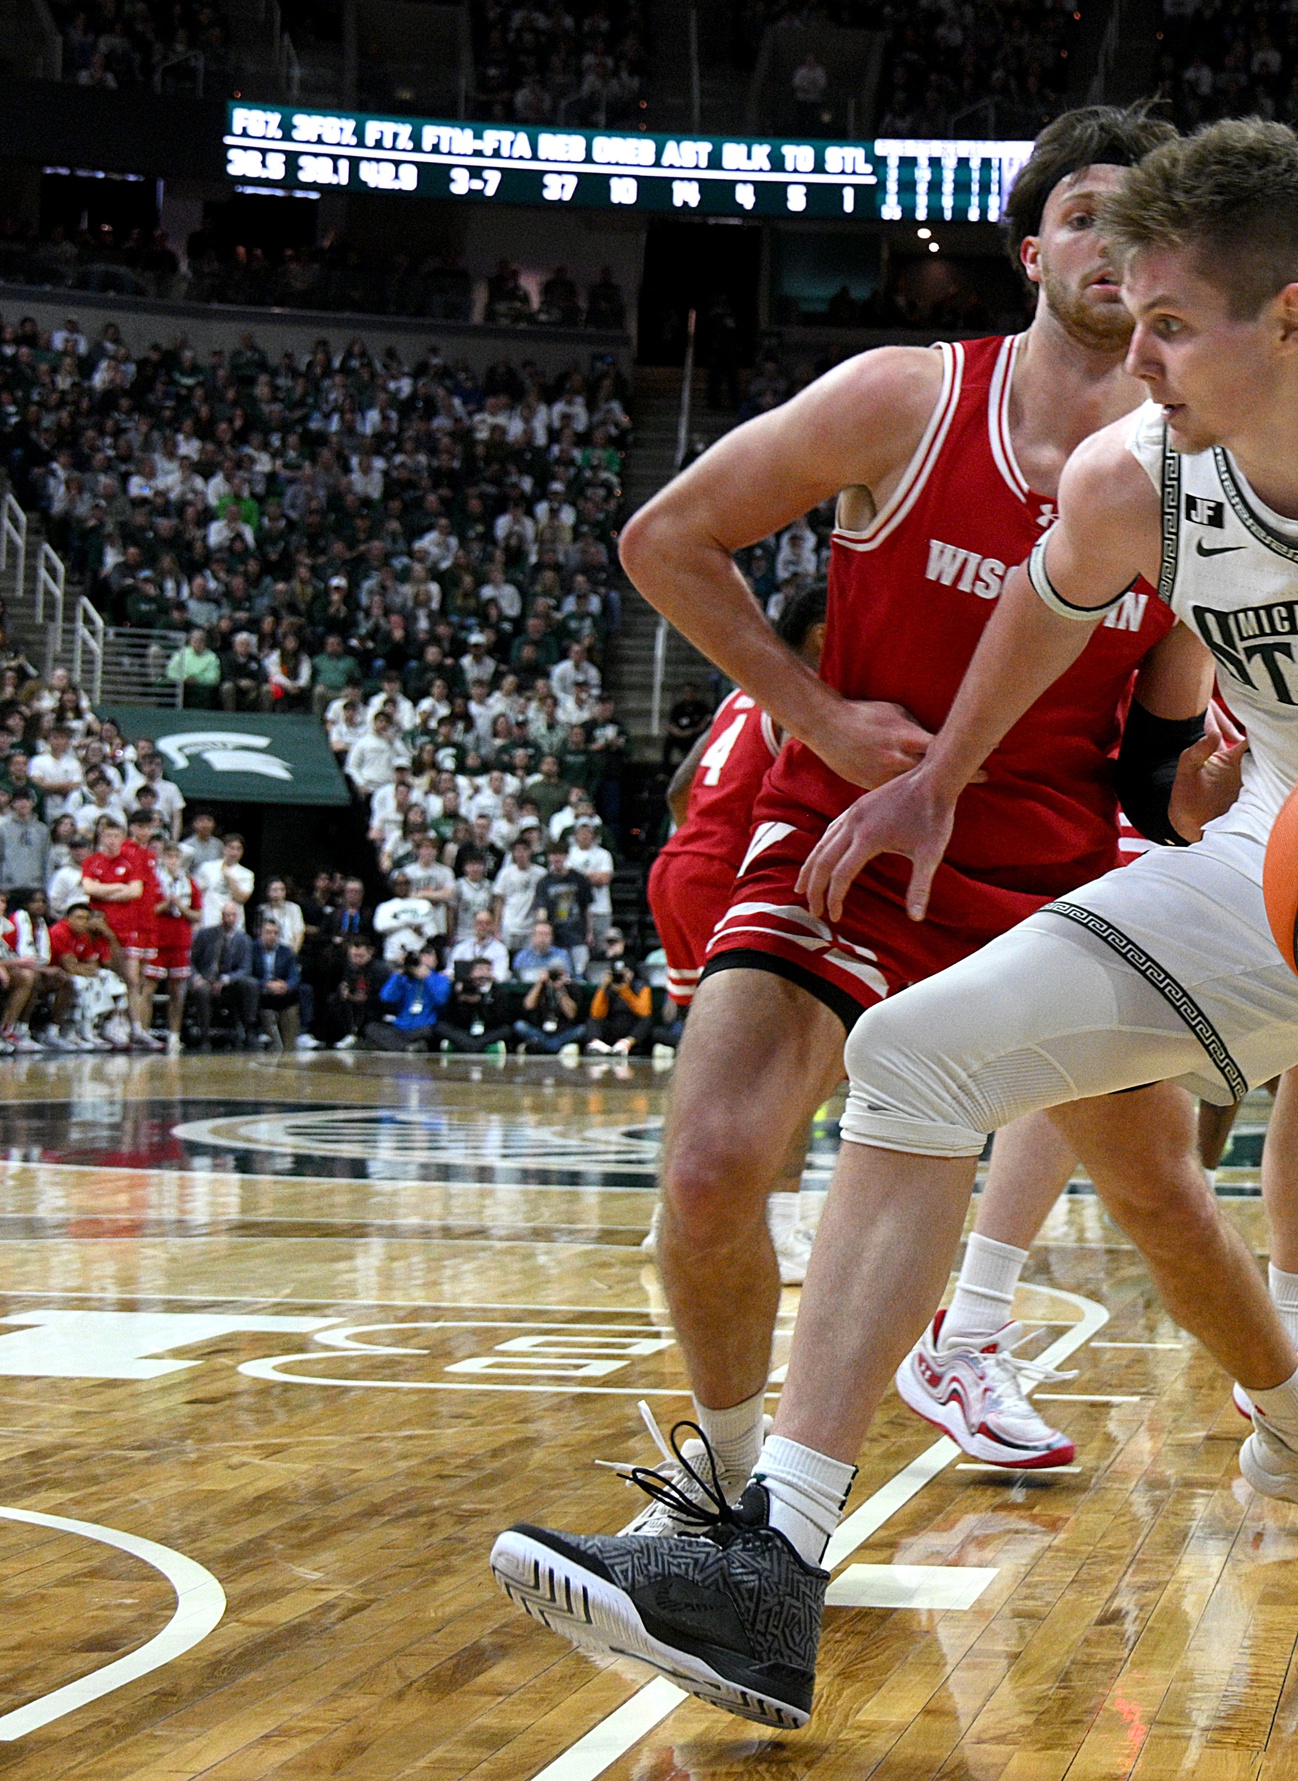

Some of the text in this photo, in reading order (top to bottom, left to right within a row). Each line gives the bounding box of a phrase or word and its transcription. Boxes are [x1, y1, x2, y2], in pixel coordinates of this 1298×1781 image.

[364, 120, 414, 150] FT%
[421, 124, 533, 159] FTM-FTA
[537, 132, 587, 162] REB
[660, 139, 713, 169] AST
[721, 142, 772, 171] BLK
[781, 144, 815, 172] TO
[824, 146, 874, 174] STL
[449, 166, 502, 197] 3-7
[542, 173, 578, 201] 37
[609, 176, 638, 205] 10
[671, 179, 701, 208] 14
[734, 182, 756, 210] 4
[786, 183, 807, 212] 5
[841, 185, 855, 213] 1
[1190, 498, 1217, 525] JF
[699, 712, 748, 787] 4
